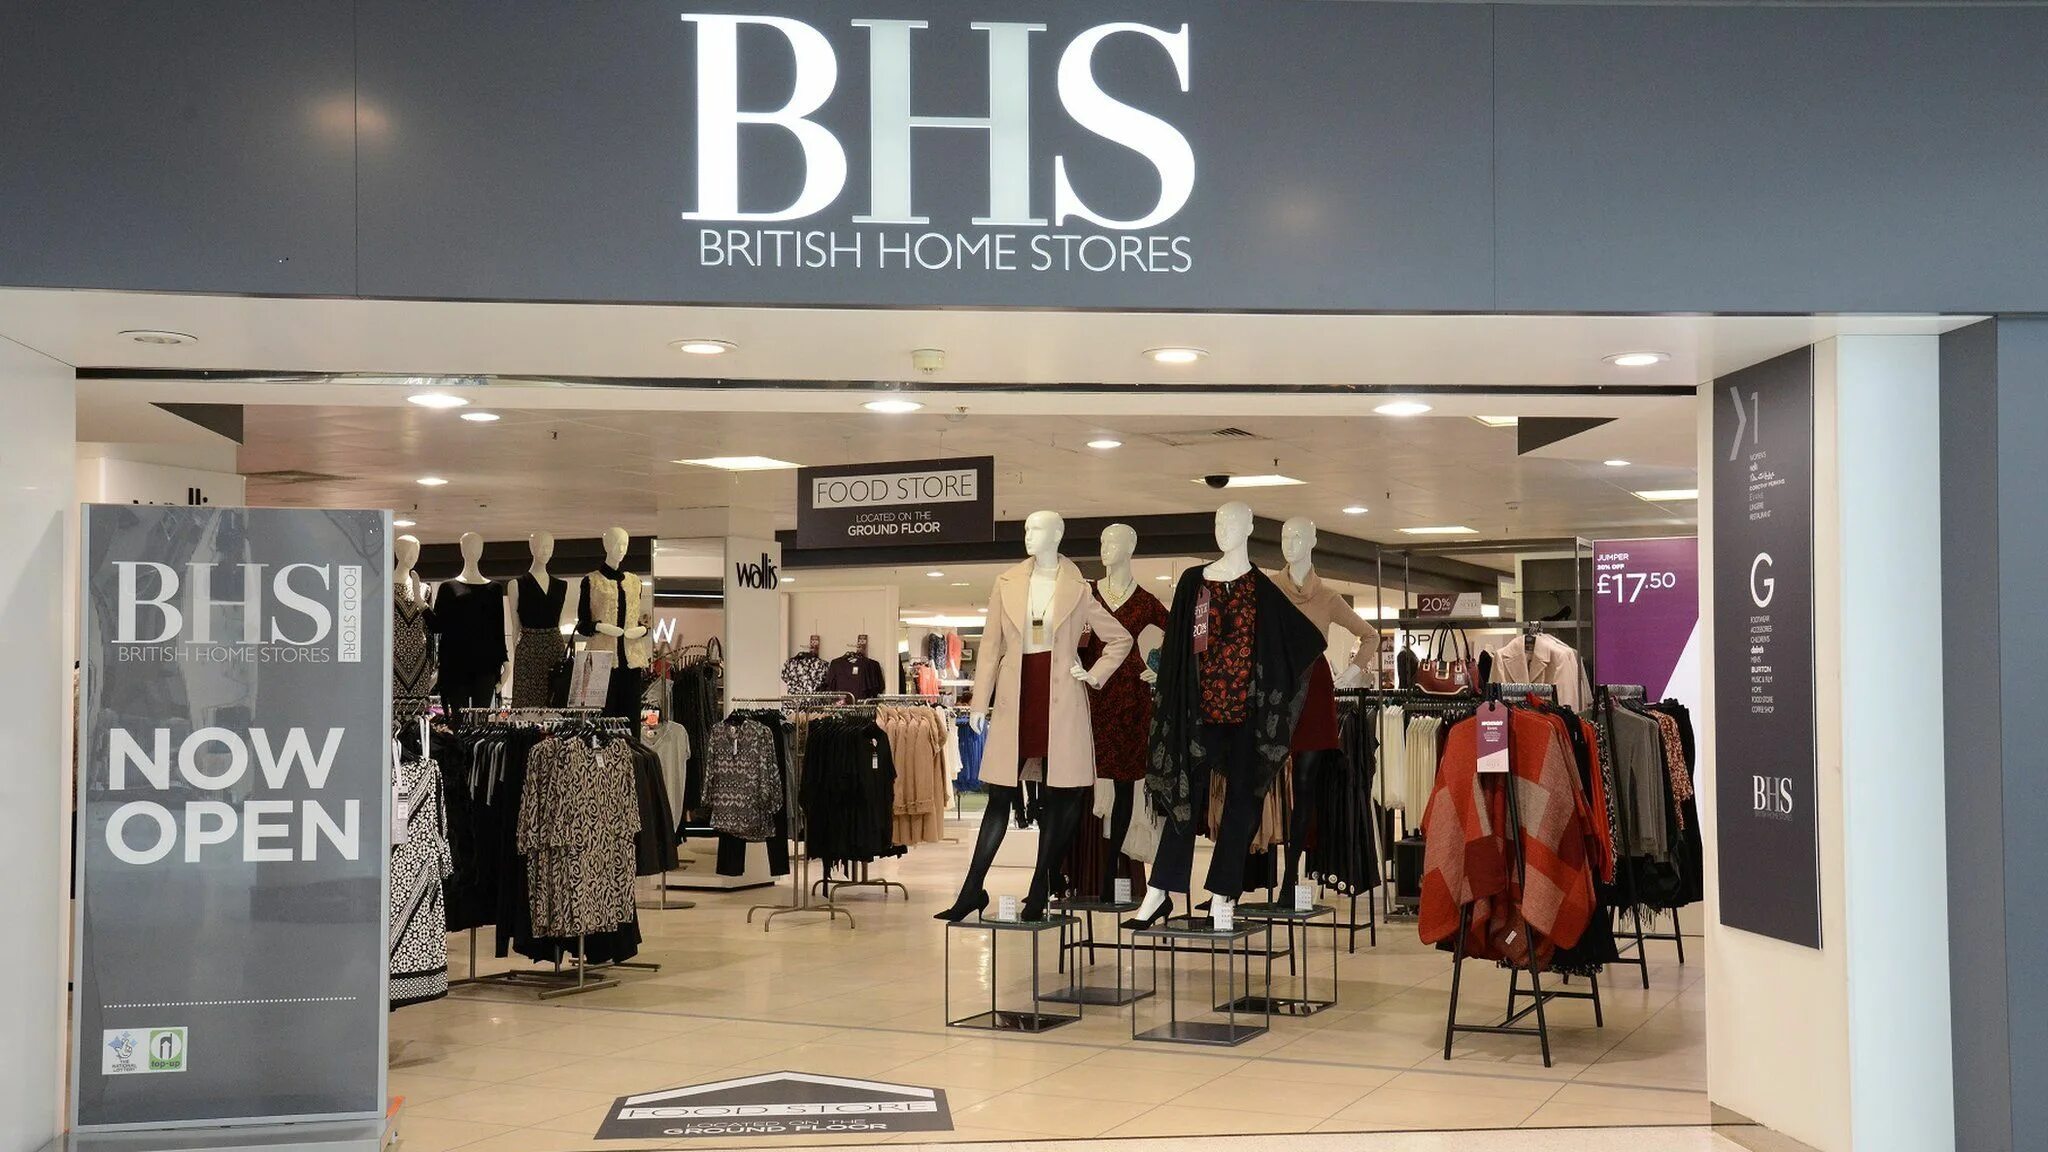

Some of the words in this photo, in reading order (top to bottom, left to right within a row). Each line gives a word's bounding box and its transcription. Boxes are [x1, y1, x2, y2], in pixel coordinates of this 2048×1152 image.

[681, 13, 1195, 230] BHS
[700, 229, 861, 268] BRITISH
[879, 232, 1016, 270] HOME
[1030, 234, 1193, 272] STORES
[817, 479, 889, 504] FOOD
[897, 473, 972, 500] STORE
[847, 524, 898, 536] GROUND
[901, 522, 940, 534] FLOOR
[856, 512, 896, 523] LOCATED
[898, 511, 912, 521] ON
[915, 510, 931, 520] THE
[736, 552, 777, 590] wallis
[1597, 553, 1630, 562] JUMPER
[343, 567, 357, 612] FOOD
[1597, 572, 1676, 603] £17.50
[1750, 552, 1775, 608] G
[111, 561, 332, 645] BHS
[1421, 597, 1451, 612] 20%
[343, 615, 357, 660] STORE
[118, 646, 188, 662] BRITISH
[195, 646, 257, 663] HOME
[260, 647, 330, 663] STORES
[1751, 665, 1772, 673] BURTON
[108, 727, 345, 790] NOW
[1752, 775, 1793, 814] BHS
[105, 799, 360, 865] OPEN
[151, 1060, 181, 1069] top-up
[628, 1106, 768, 1118] FOOD
[786, 1103, 928, 1114] STORE
[663, 1126, 787, 1135] GROUND
[795, 1123, 888, 1132] FLOOR
